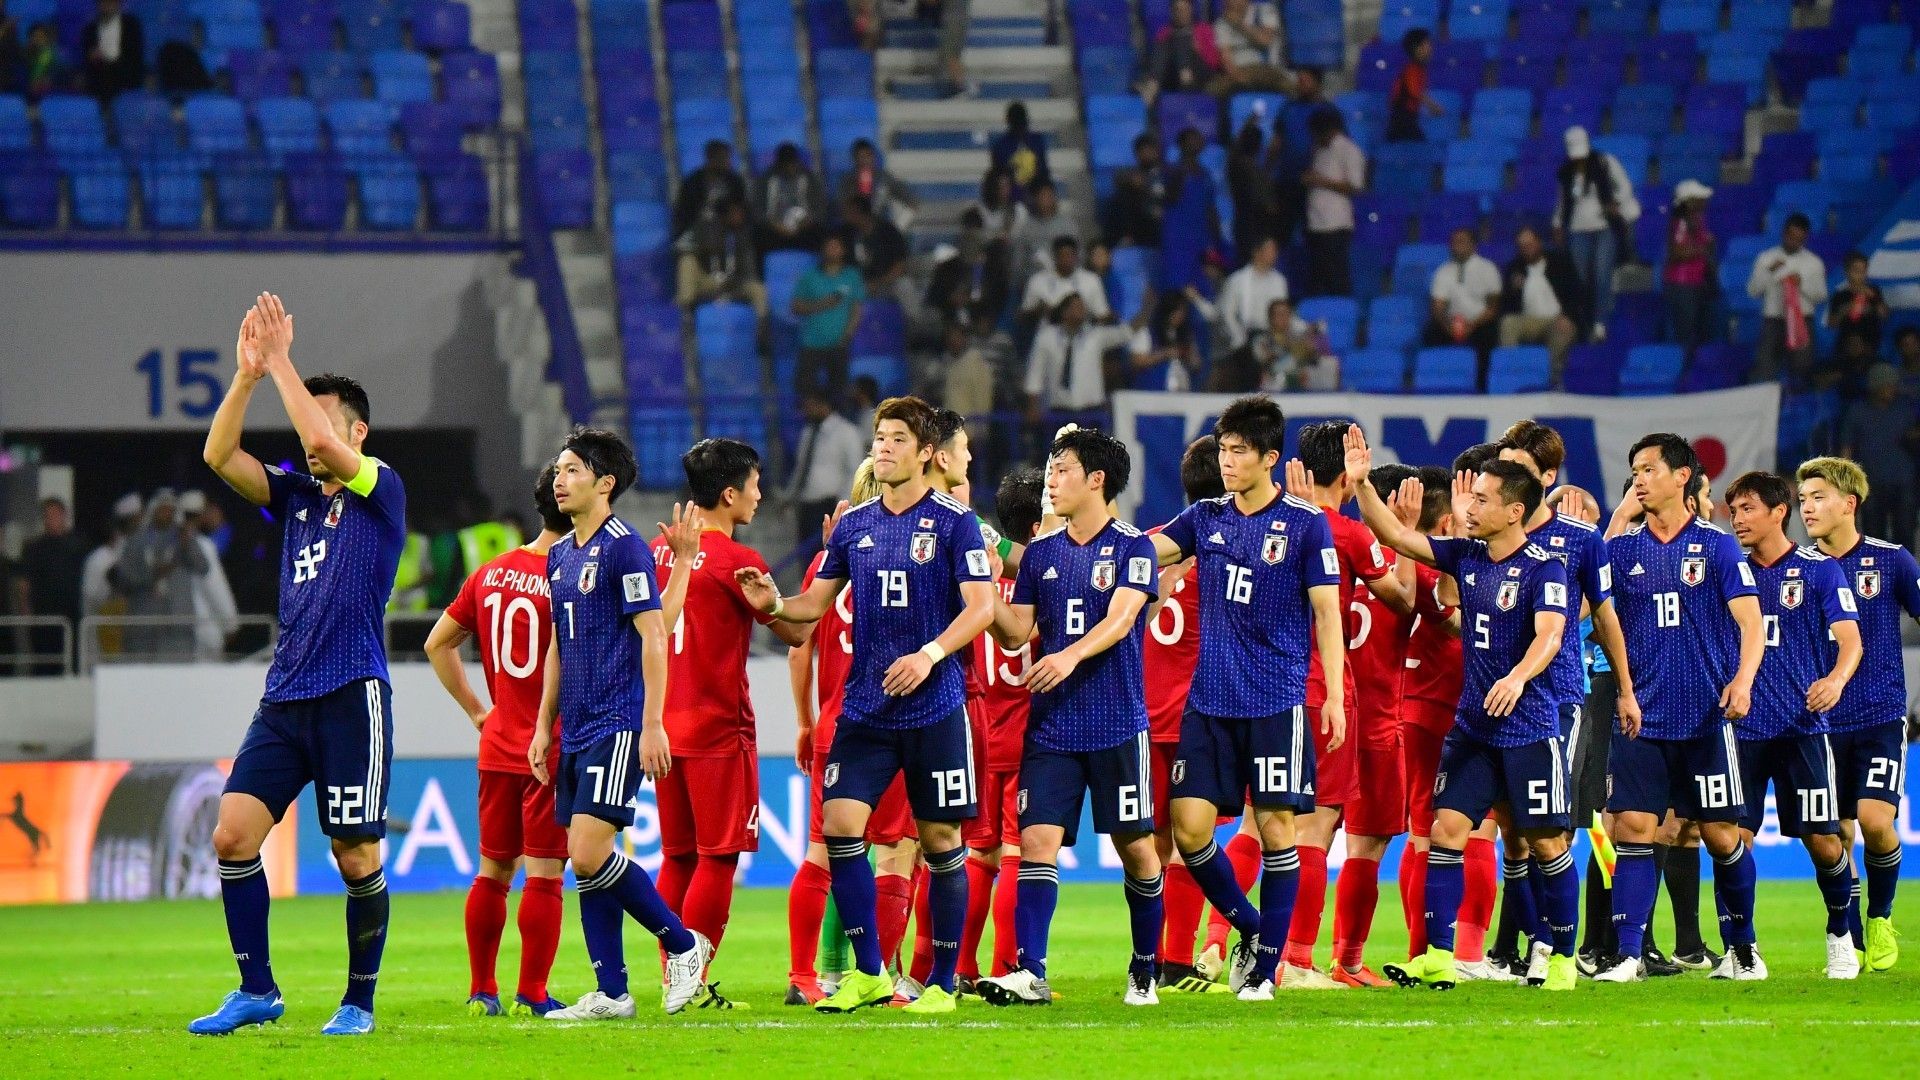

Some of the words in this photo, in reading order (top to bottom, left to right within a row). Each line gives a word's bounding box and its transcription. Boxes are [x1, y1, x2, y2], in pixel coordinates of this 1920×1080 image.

[135, 348, 225, 419] 15
[294, 540, 325, 583] 22
[878, 570, 907, 606] 19
[1226, 564, 1252, 604] 16
[1066, 599, 1084, 634] 6
[1653, 592, 1679, 627] 18
[483, 591, 540, 679] 10
[1475, 613, 1489, 649] 5
[1763, 614, 1780, 648] 0
[932, 769, 967, 807] 19
[1255, 757, 1287, 791] 16
[1695, 774, 1727, 807] 18
[1867, 758, 1898, 791] 21
[328, 786, 363, 824] 22
[1119, 785, 1138, 821] 6
[1529, 780, 1547, 814] 5
[1798, 788, 1828, 821] 10
[844, 926, 864, 936] PAN
[932, 939, 957, 949] APAN
[1258, 944, 1278, 954] PAN
[350, 972, 378, 981] JAPA
